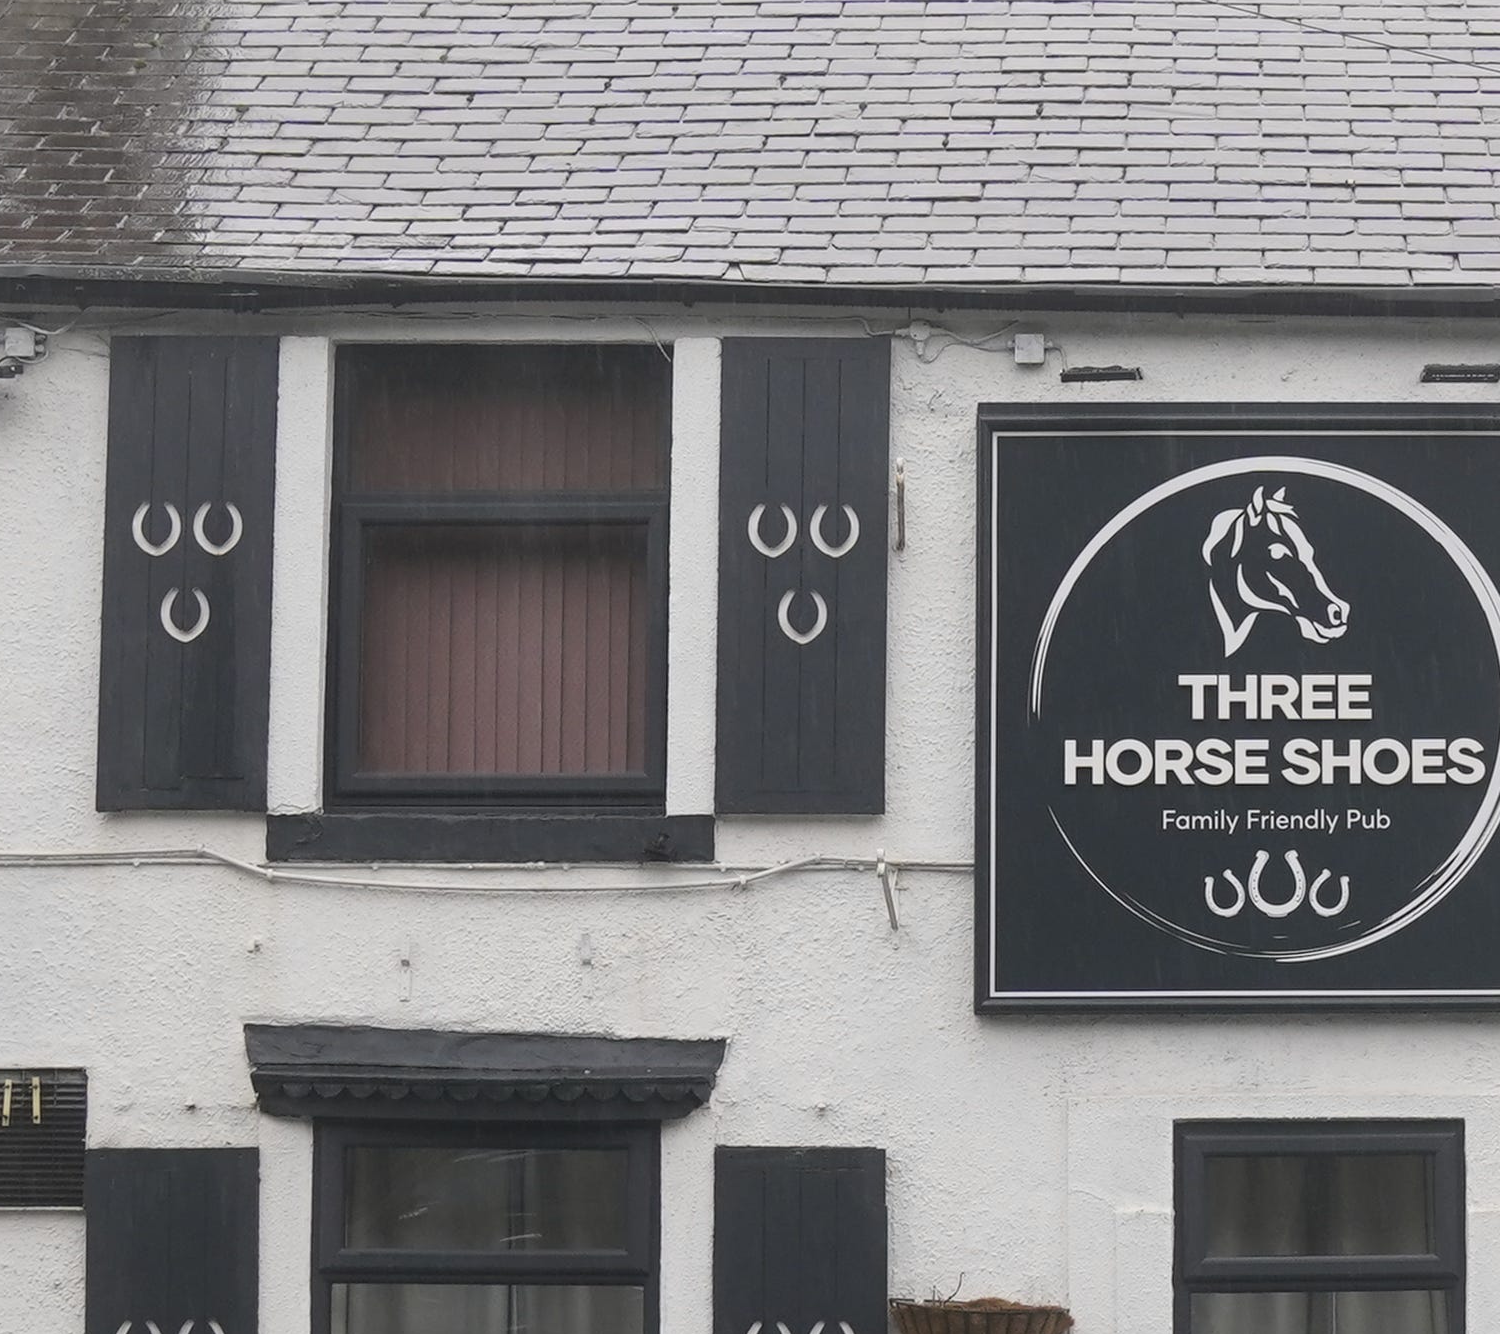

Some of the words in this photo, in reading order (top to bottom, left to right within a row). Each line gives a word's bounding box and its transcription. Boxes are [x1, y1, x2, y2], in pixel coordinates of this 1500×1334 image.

[1178, 674, 1373, 720] THREE
[1064, 738, 1270, 786] HORSE
[1281, 737, 1486, 785] SHOES
[1162, 809, 1239, 834] Family
[1246, 809, 1339, 834] Friendly
[1347, 809, 1391, 830] Pub
